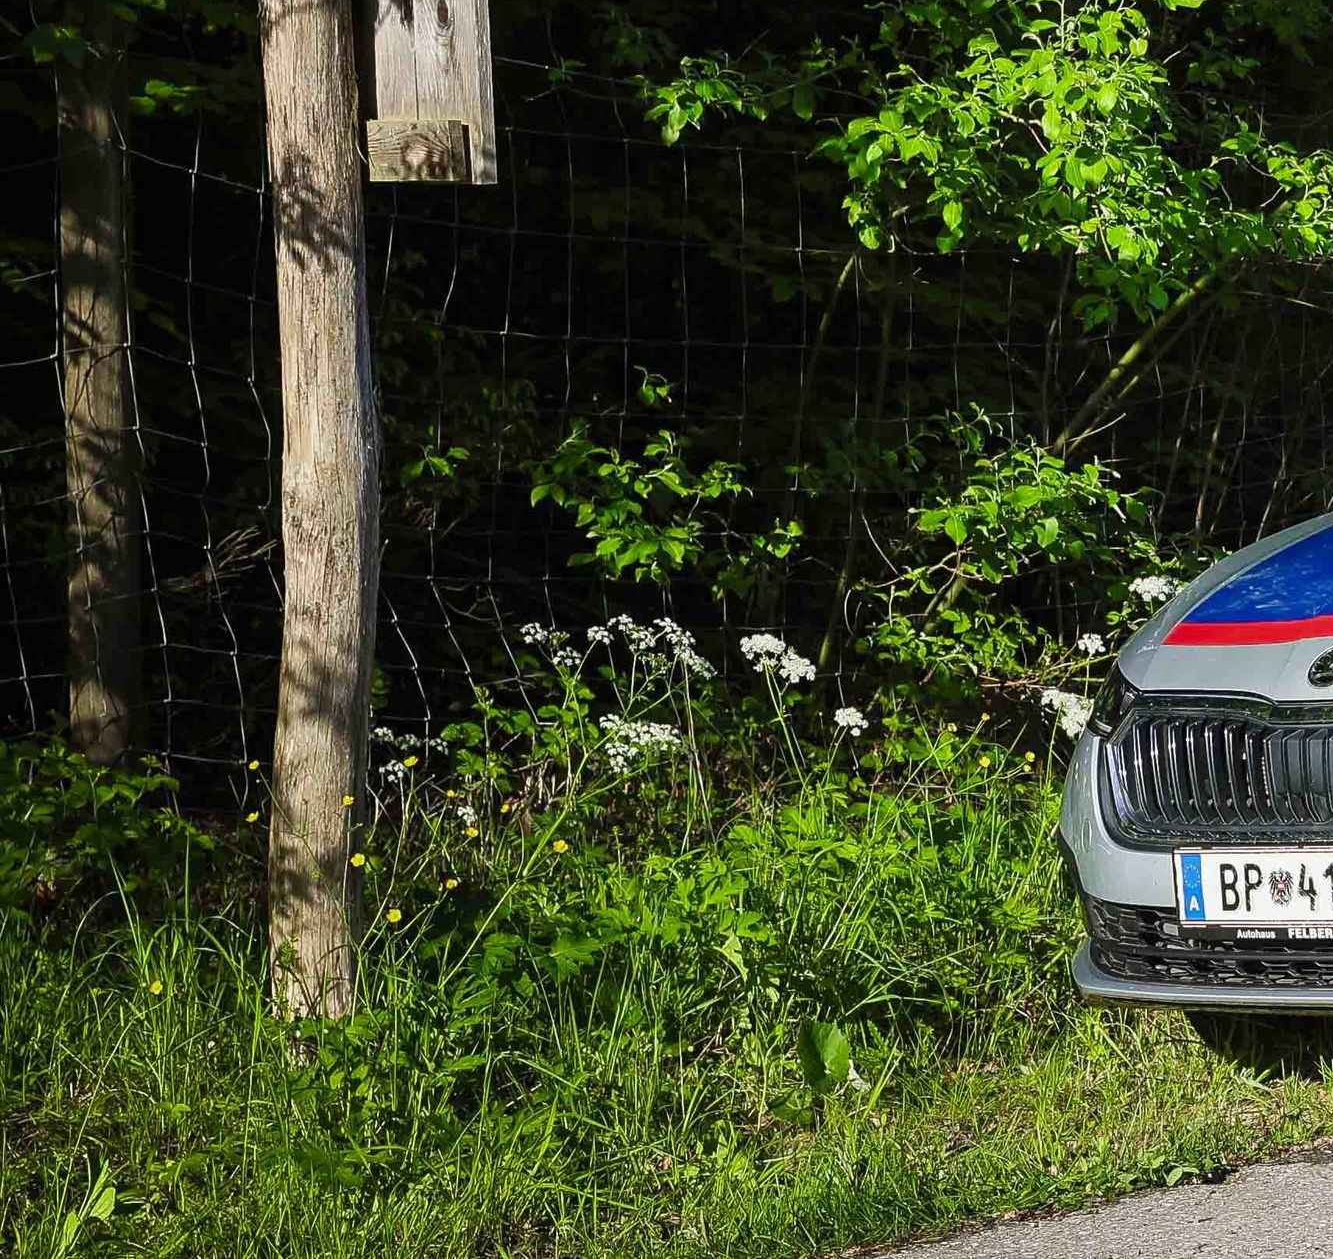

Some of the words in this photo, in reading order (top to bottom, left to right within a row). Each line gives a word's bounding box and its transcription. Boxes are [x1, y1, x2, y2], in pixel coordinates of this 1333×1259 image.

[1219, 863, 1264, 912] BP
[1189, 894, 1201, 912] A
[1236, 928, 1277, 940] Autohaus
